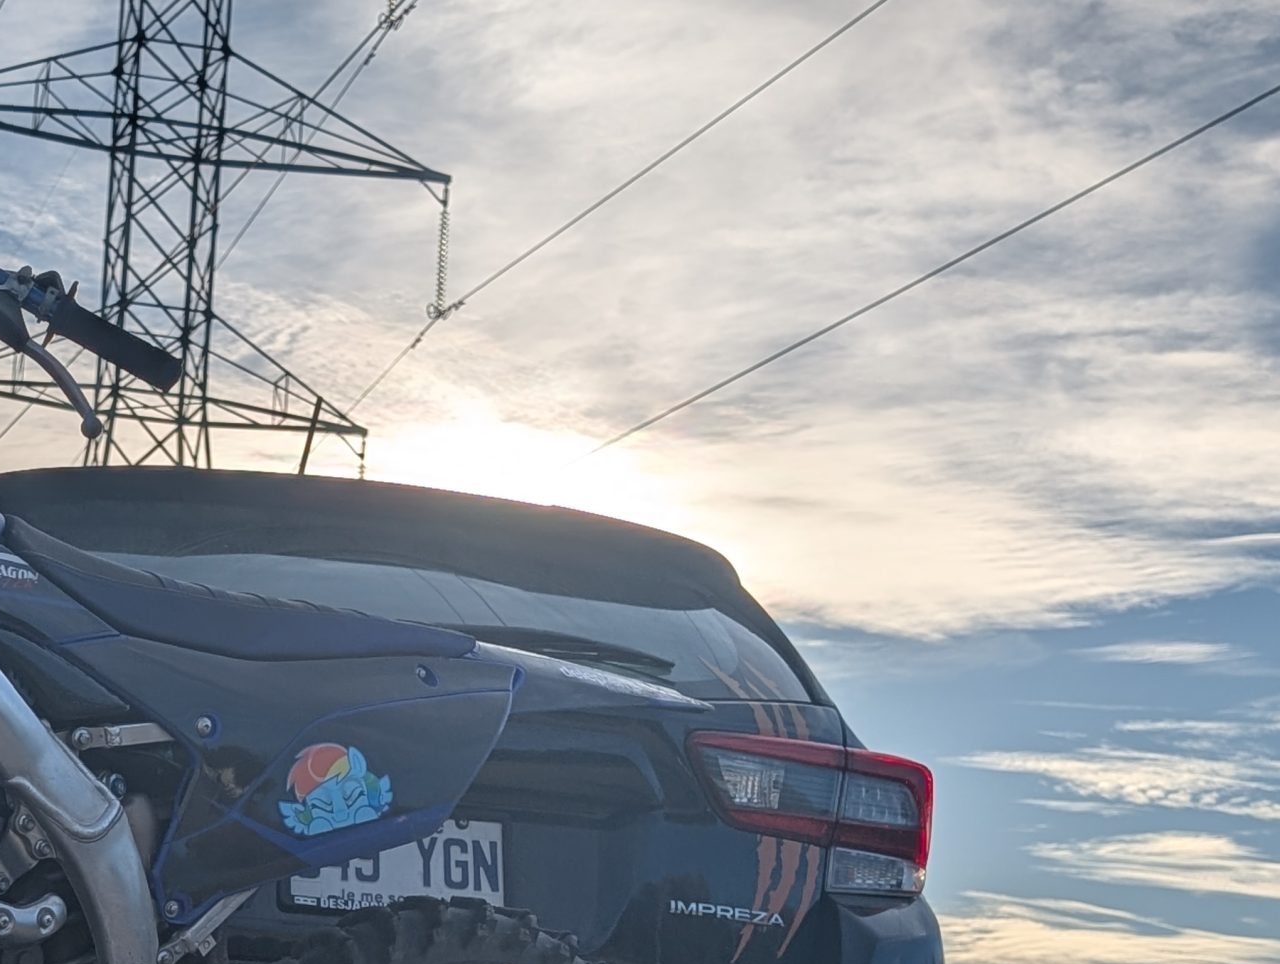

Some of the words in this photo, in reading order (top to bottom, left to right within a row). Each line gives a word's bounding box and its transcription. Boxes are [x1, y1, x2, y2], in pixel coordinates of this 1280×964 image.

[417, 837, 500, 893] YGN
[361, 891, 384, 902] me
[669, 899, 785, 927] IMPREZA
